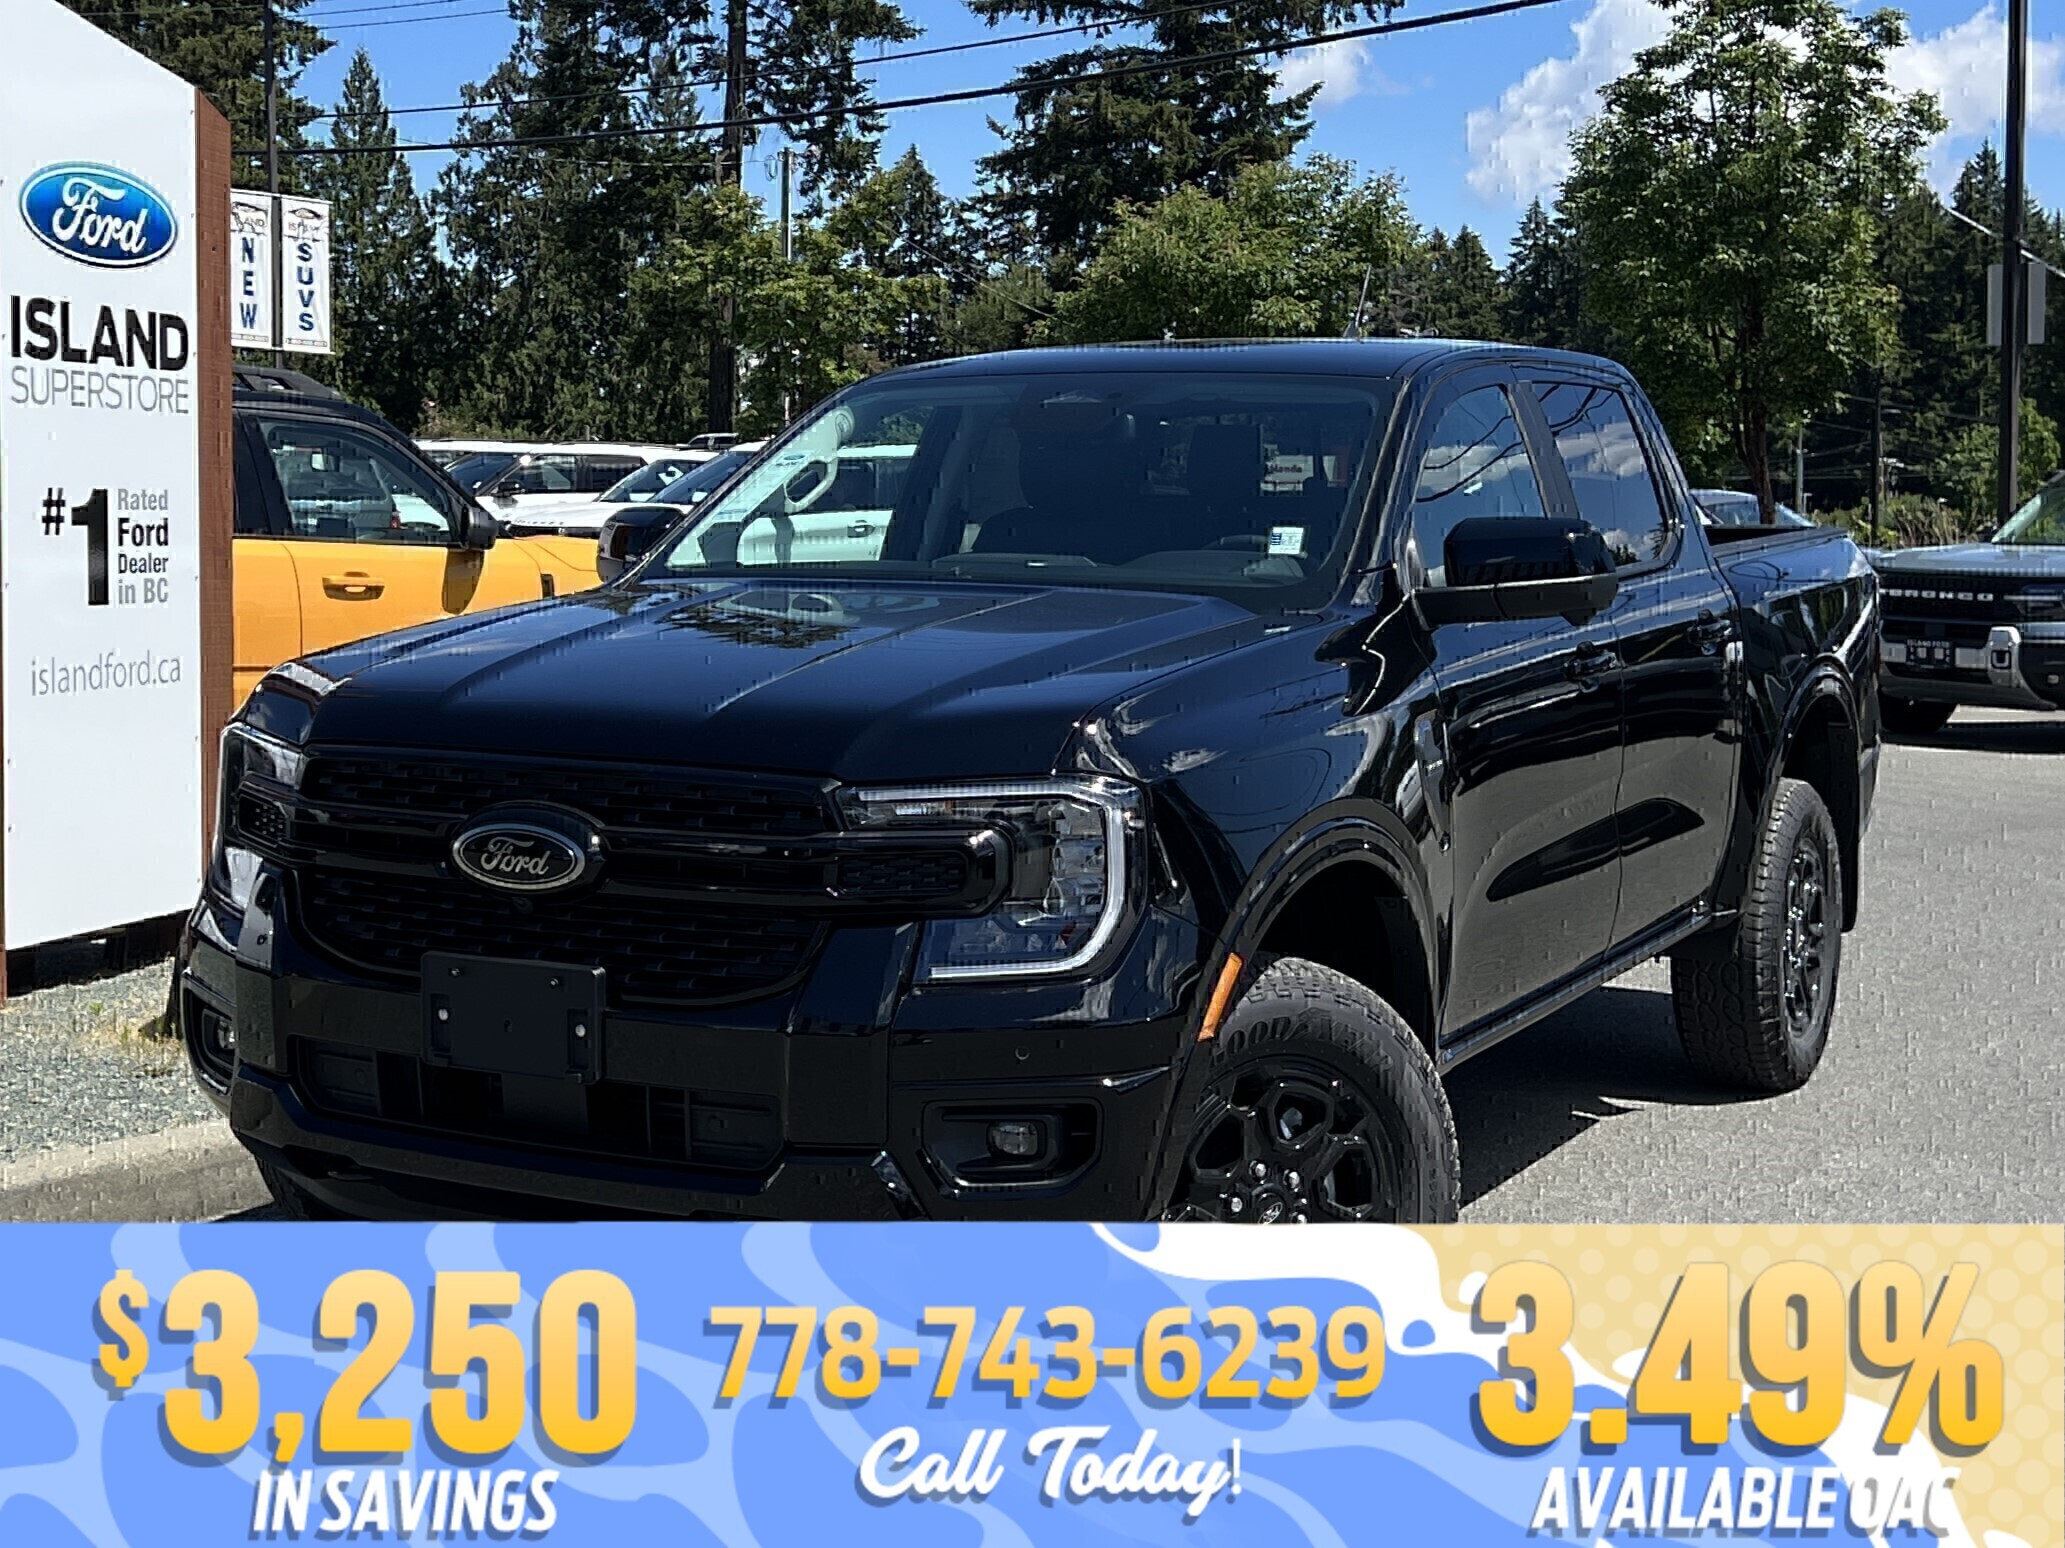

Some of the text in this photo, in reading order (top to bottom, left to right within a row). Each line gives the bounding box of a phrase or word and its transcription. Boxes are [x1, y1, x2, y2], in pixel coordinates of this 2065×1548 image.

[52, 176, 148, 254] Ford
[240, 236, 257, 329] NEW
[296, 242, 314, 331] SUVS
[10, 295, 189, 371] ISLAND
[10, 365, 189, 414] SUPERSTORE
[117, 488, 169, 511] Rated
[41, 487, 110, 606] #1
[117, 517, 169, 547] Ford
[117, 552, 169, 574] Dealer
[117, 577, 169, 605] in BC
[31, 649, 182, 697] islandford.ca
[480, 836, 551, 876] Ford
